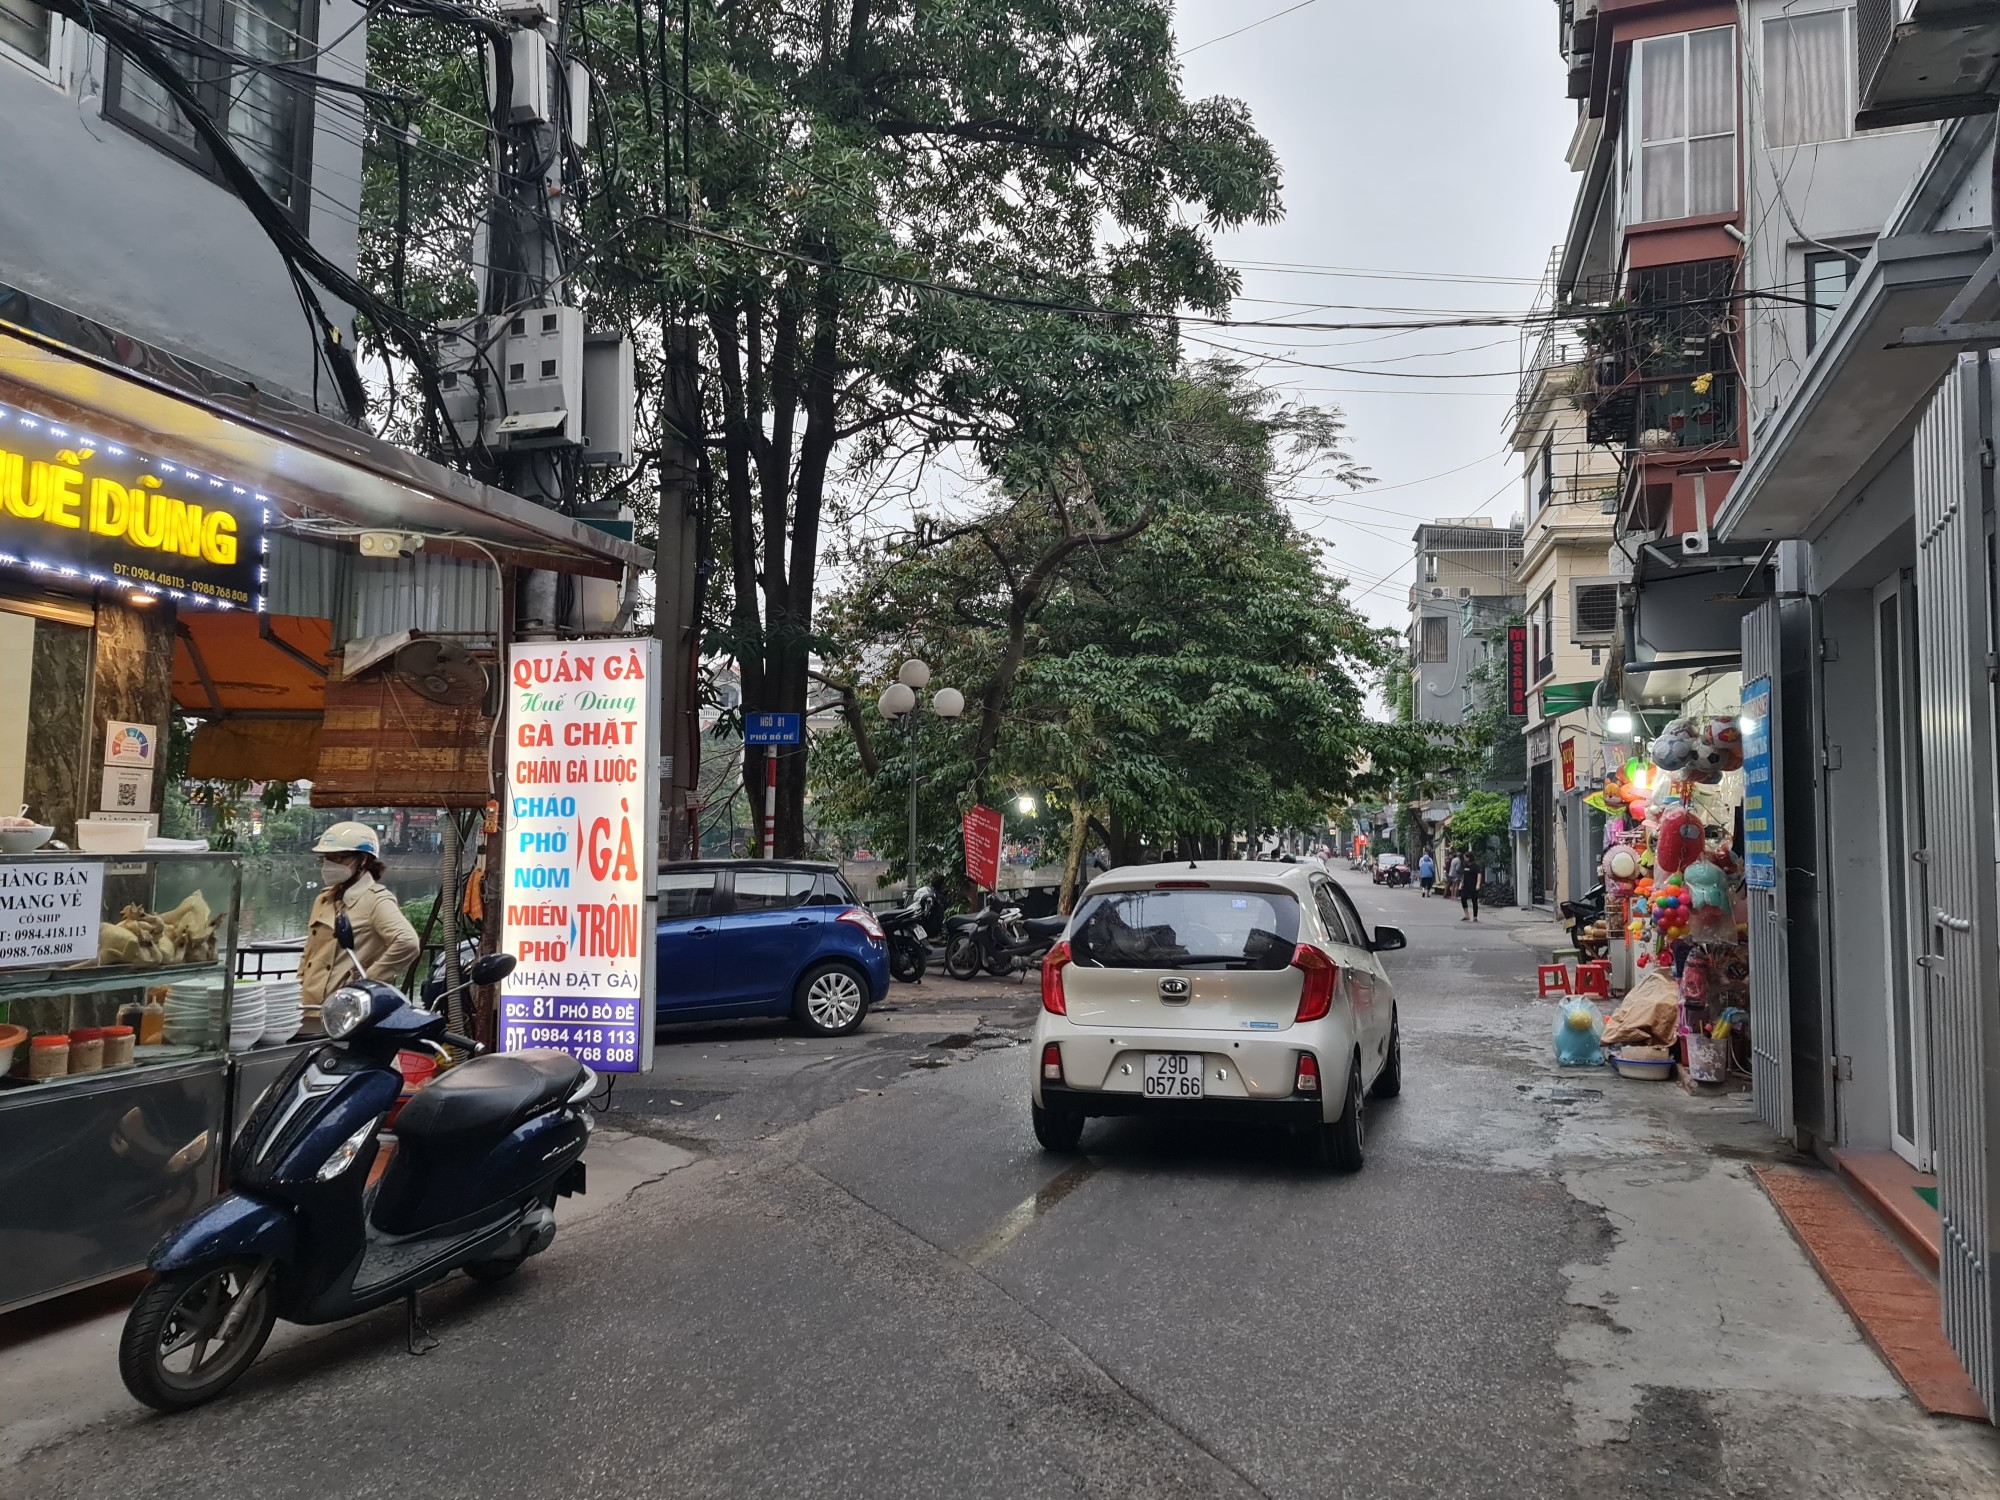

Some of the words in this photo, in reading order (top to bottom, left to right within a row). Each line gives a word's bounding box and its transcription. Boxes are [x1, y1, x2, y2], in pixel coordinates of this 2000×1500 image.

[0, 448, 96, 529] UẾ
[89, 474, 237, 565] DŨNG
[131, 566, 156, 583] 0984
[191, 580, 215, 596] 0988
[513, 650, 596, 689] QUÁN
[603, 647, 645, 680] GÀ
[520, 692, 567, 713] Huế
[574, 691, 637, 714] Dũng
[777, 716, 785, 727] 81
[518, 719, 554, 748] GÀ
[564, 717, 638, 749] CHẶT
[516, 755, 561, 784] CHÂN
[566, 754, 588, 783] GÀ
[594, 754, 637, 786] LUỘC
[513, 793, 576, 818] CHÁO
[519, 826, 570, 853] PHỞ
[588, 797, 639, 882] GÀ
[53, 867, 89, 886] BÁN
[514, 863, 570, 892] NỘM
[0, 893, 54, 910] MANG
[18, 913, 35, 924] CÓ
[37, 913, 61, 924] SHIP
[507, 900, 568, 926] MIẾN
[14, 925, 87, 941] 0984.418.113
[577, 893, 637, 966] TRỘN
[0, 942, 73, 959] 0988.768.808
[518, 935, 569, 962] PHỞ
[507, 970, 560, 990] (NHẬN
[566, 971, 601, 991] ĐẶT
[607, 970, 638, 991] GÀ)
[1162, 982, 1184, 992] KIA
[506, 1003, 529, 1017] ĐC:
[533, 997, 554, 1018] 81
[531, 1027, 570, 1042] 0984
[573, 1029, 602, 1044] 418
[607, 1030, 635, 1044] 113
[574, 1046, 602, 1061] 768
[606, 1048, 634, 1062] 808
[1157, 1056, 1188, 1075] 29D
[1146, 1076, 1200, 1096] 057.66
